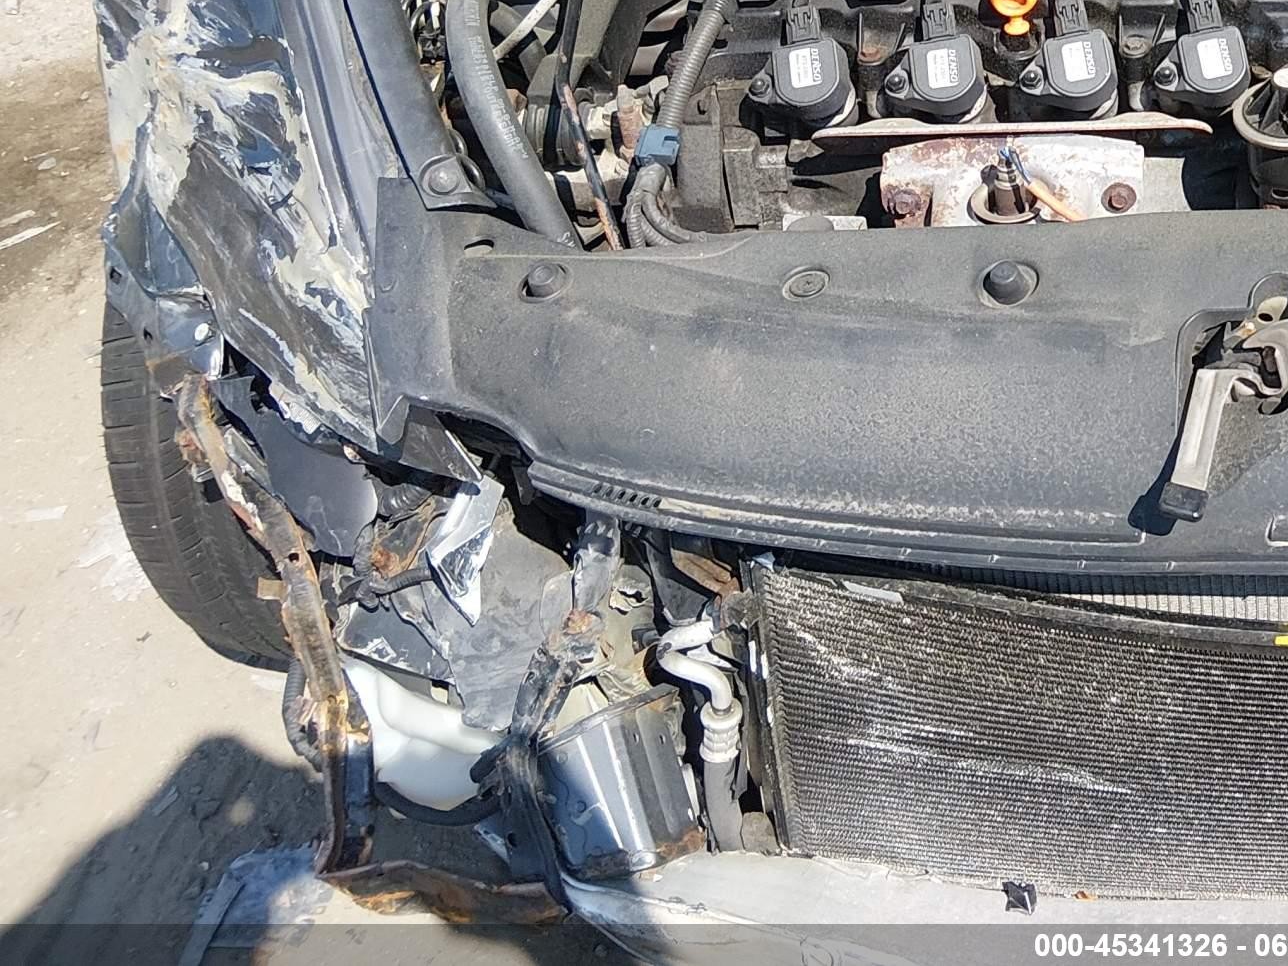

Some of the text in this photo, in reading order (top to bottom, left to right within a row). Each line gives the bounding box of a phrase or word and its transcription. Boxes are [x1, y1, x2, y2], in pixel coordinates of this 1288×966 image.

[811, 48, 822, 82] DENSO
[949, 50, 959, 83] DENSO
[1083, 42, 1096, 75] DENSO
[1219, 38, 1233, 72] DENSO
